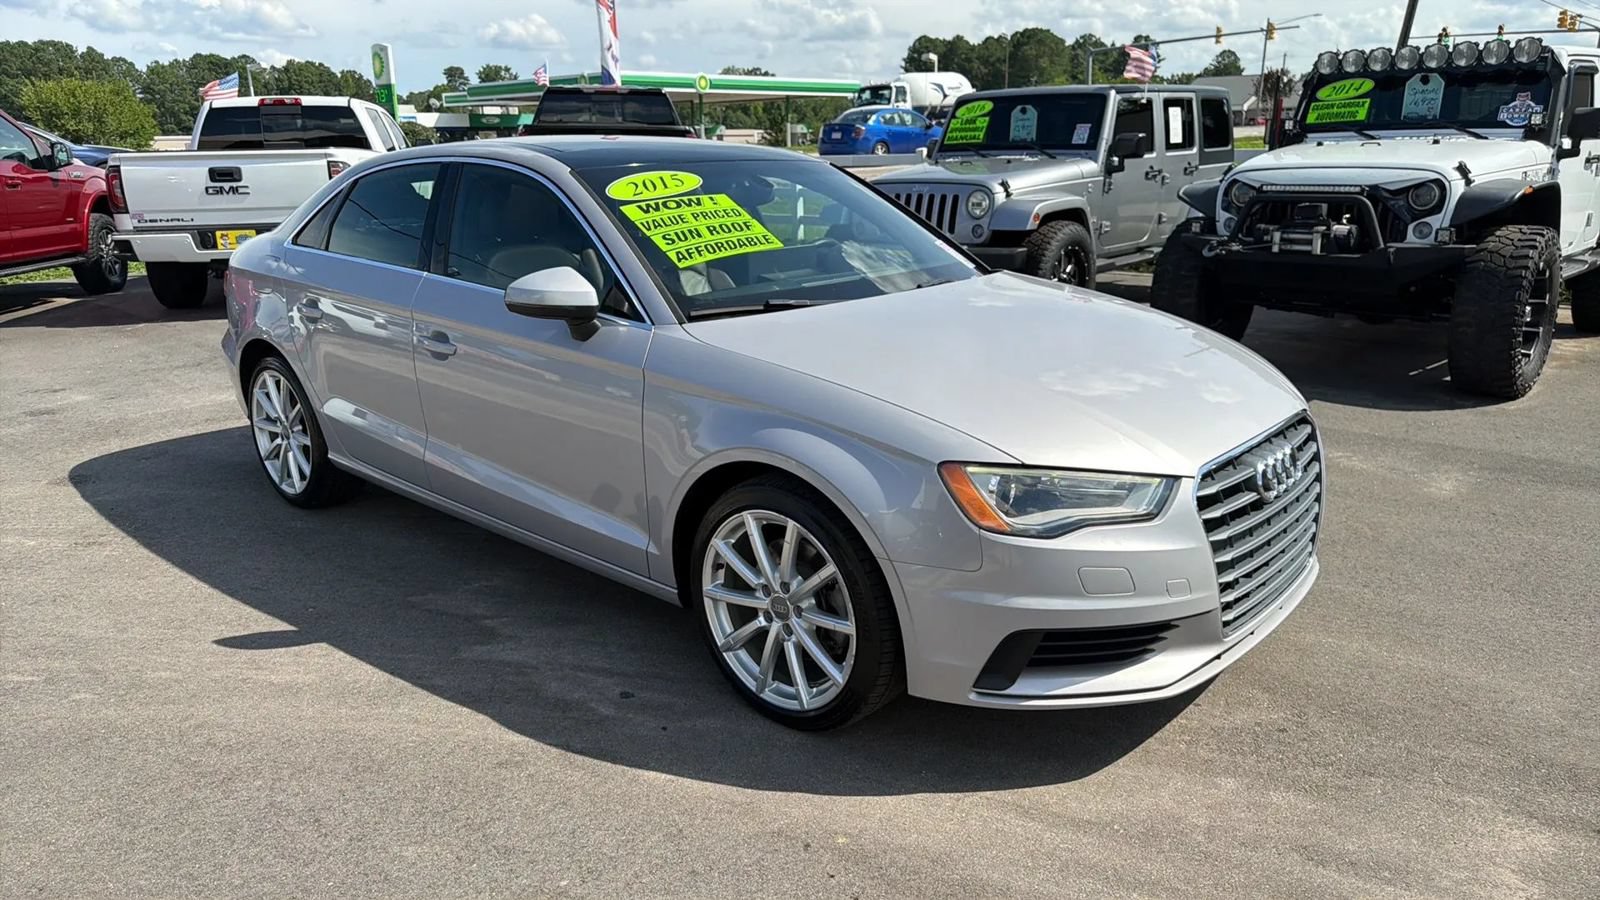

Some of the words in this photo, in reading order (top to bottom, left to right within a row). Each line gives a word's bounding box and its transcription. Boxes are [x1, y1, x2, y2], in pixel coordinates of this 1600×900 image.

[1324, 79, 1366, 98] 2014
[1311, 102, 1336, 111] CLEAN
[205, 185, 250, 195] GMC
[625, 173, 685, 197] 2015
[636, 196, 704, 214] WOW
[640, 213, 689, 232] VALUE
[693, 208, 743, 227] PRICED
[661, 229, 703, 246] SUN
[705, 221, 754, 236] ROOF
[675, 234, 774, 263] AFFORDABLE
